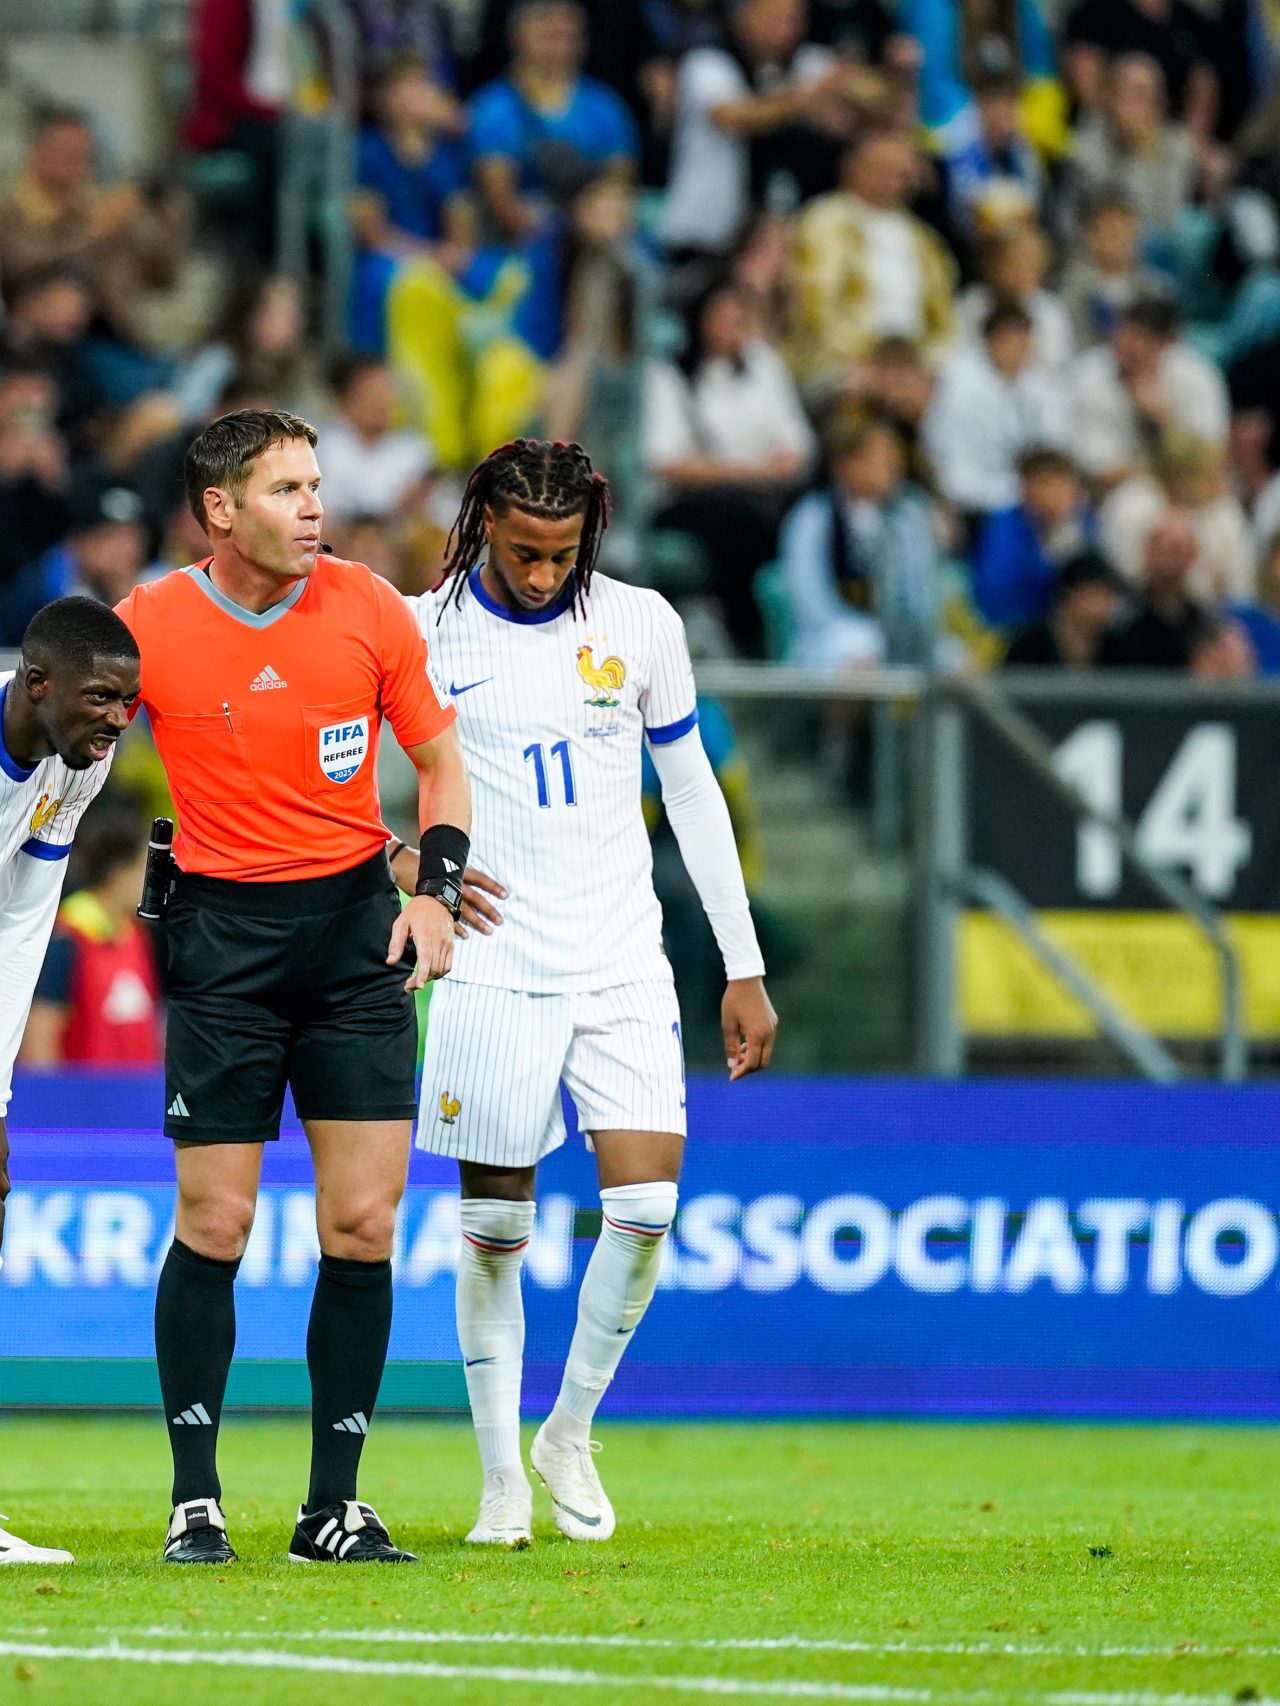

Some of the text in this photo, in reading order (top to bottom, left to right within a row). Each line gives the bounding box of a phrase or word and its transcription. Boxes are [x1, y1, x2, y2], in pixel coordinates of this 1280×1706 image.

[250, 679, 287, 692] adidas
[324, 724, 364, 746] FIFA
[323, 746, 364, 763] REFEREE
[334, 768, 353, 780] 2025
[523, 740, 577, 808] 11
[1053, 719, 1253, 899] 14
